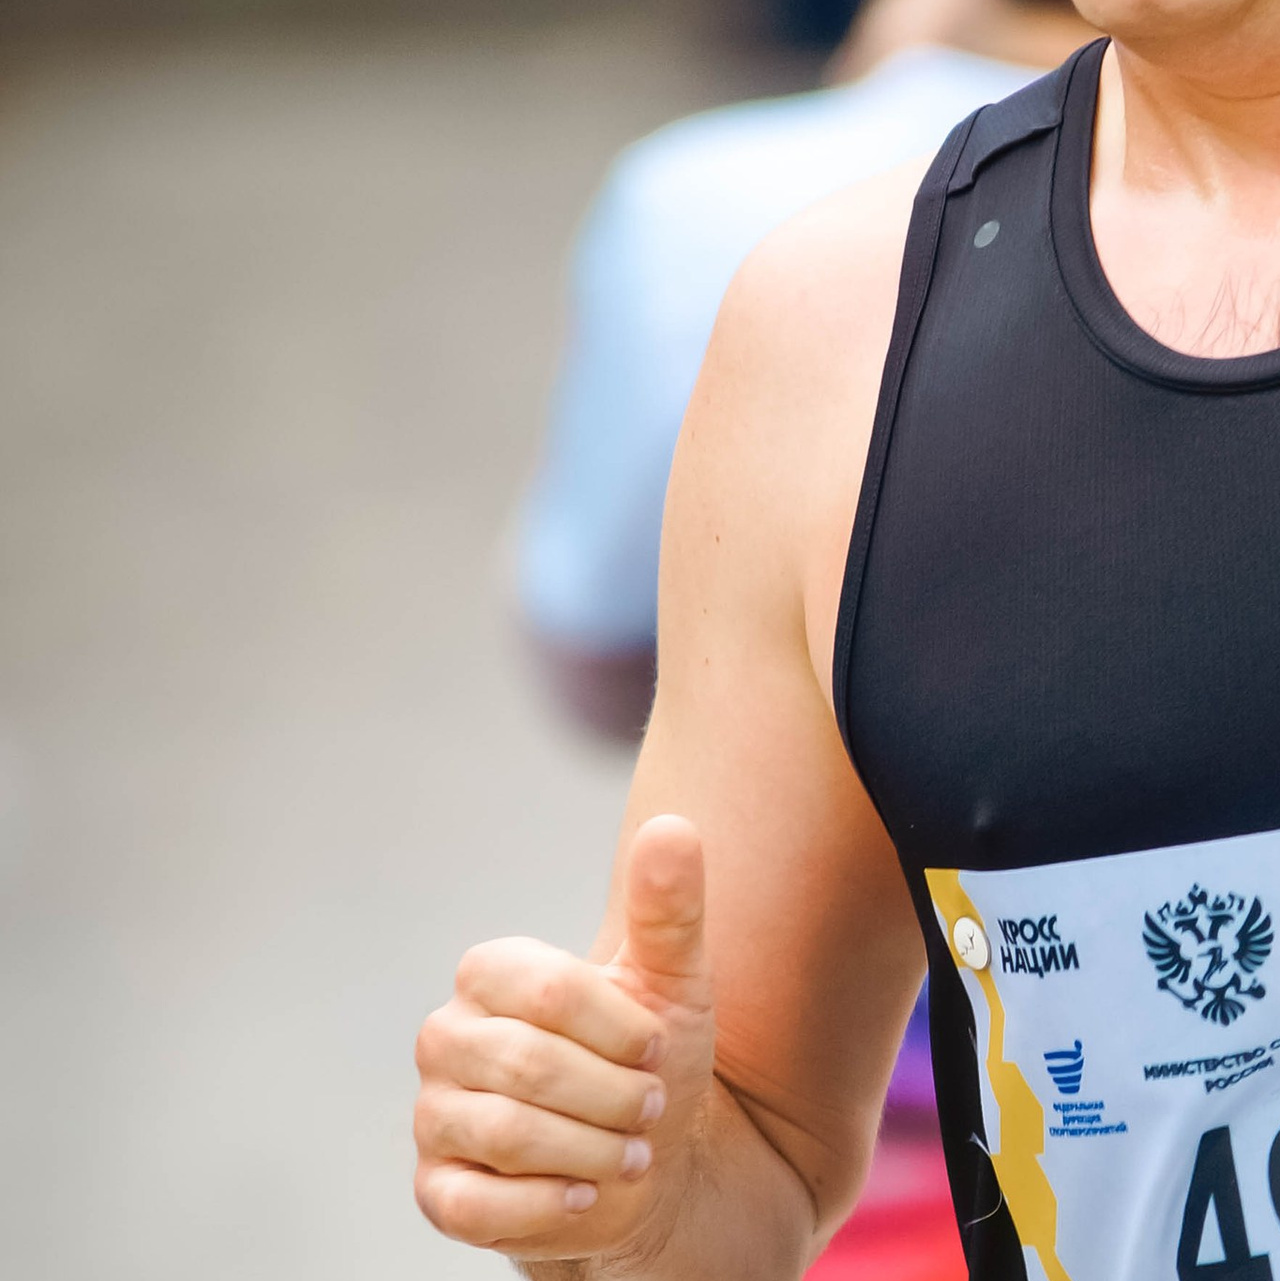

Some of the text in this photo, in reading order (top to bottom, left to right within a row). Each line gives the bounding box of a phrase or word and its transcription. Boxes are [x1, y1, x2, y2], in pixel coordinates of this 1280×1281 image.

[997, 914, 1061, 945] КРОСС
[1000, 940, 1080, 979] НАЦИИ
[1144, 1046, 1265, 1080] МИНИСТЕРСТВО
